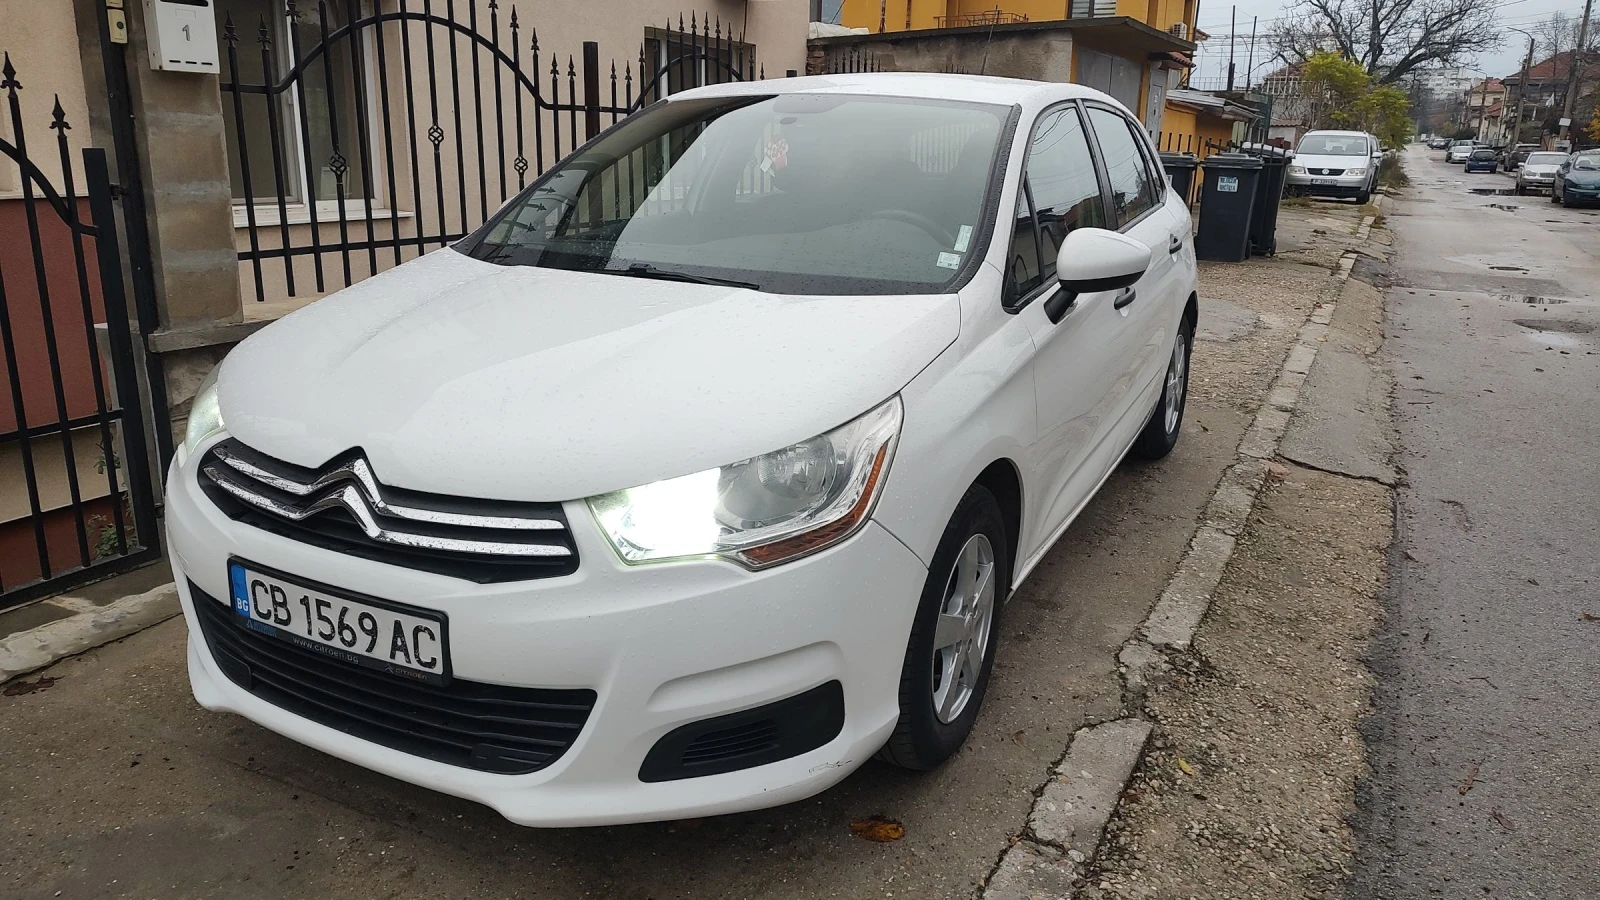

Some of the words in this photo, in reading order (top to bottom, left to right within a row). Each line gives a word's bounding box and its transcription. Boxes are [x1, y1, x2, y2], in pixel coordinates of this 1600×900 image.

[182, 24, 191, 41] 1
[236, 597, 249, 612] BG
[250, 579, 292, 627] CB
[299, 594, 379, 653] 1569
[389, 619, 437, 669] AC
[292, 636, 359, 665] www.citroen.bg
